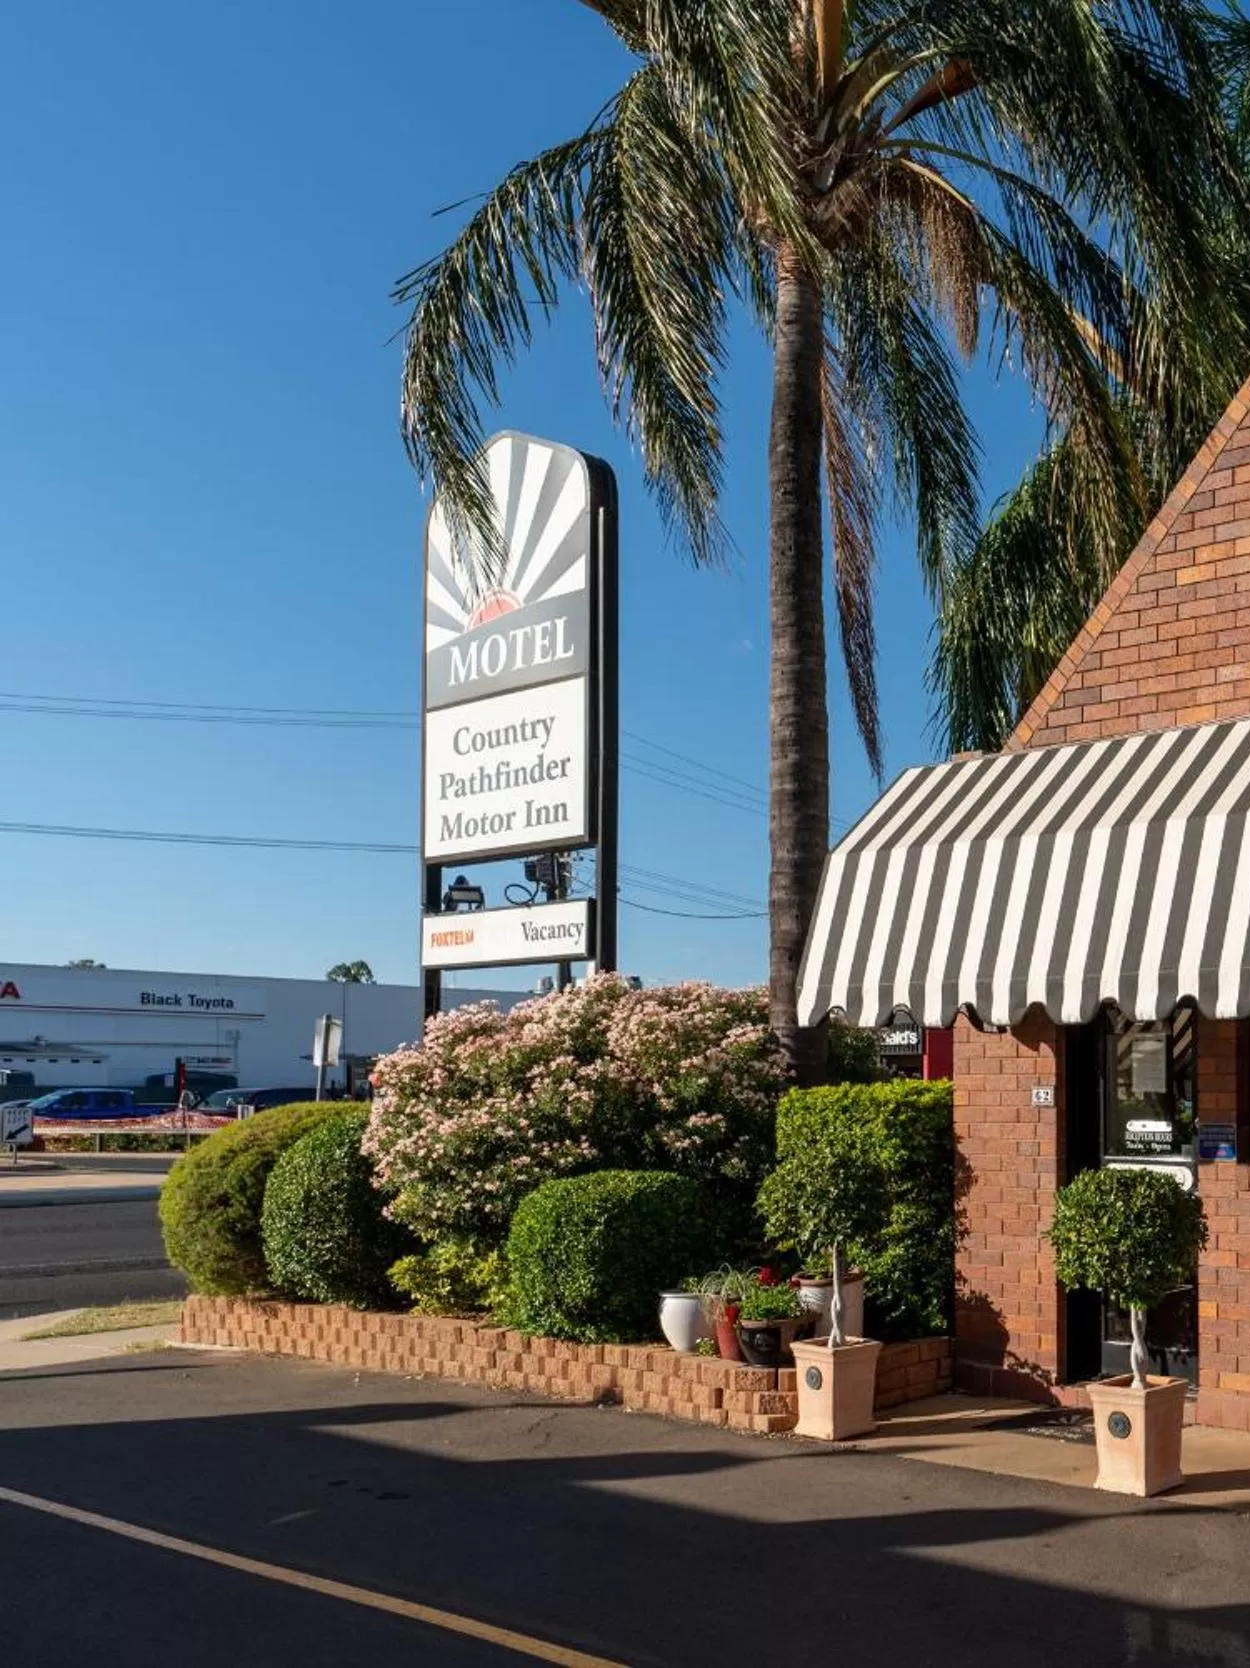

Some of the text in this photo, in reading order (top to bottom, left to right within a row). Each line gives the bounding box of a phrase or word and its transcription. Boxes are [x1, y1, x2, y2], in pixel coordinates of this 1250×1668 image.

[448, 616, 574, 687] MOTEL
[453, 715, 556, 756] Country
[439, 752, 571, 801] Pathfinder
[439, 799, 569, 842] Motor Inn
[431, 930, 464, 948] FOXTEL
[521, 920, 584, 946] Vacancy
[0, 981, 20, 1000] A
[140, 991, 235, 1010] Black Toyota
